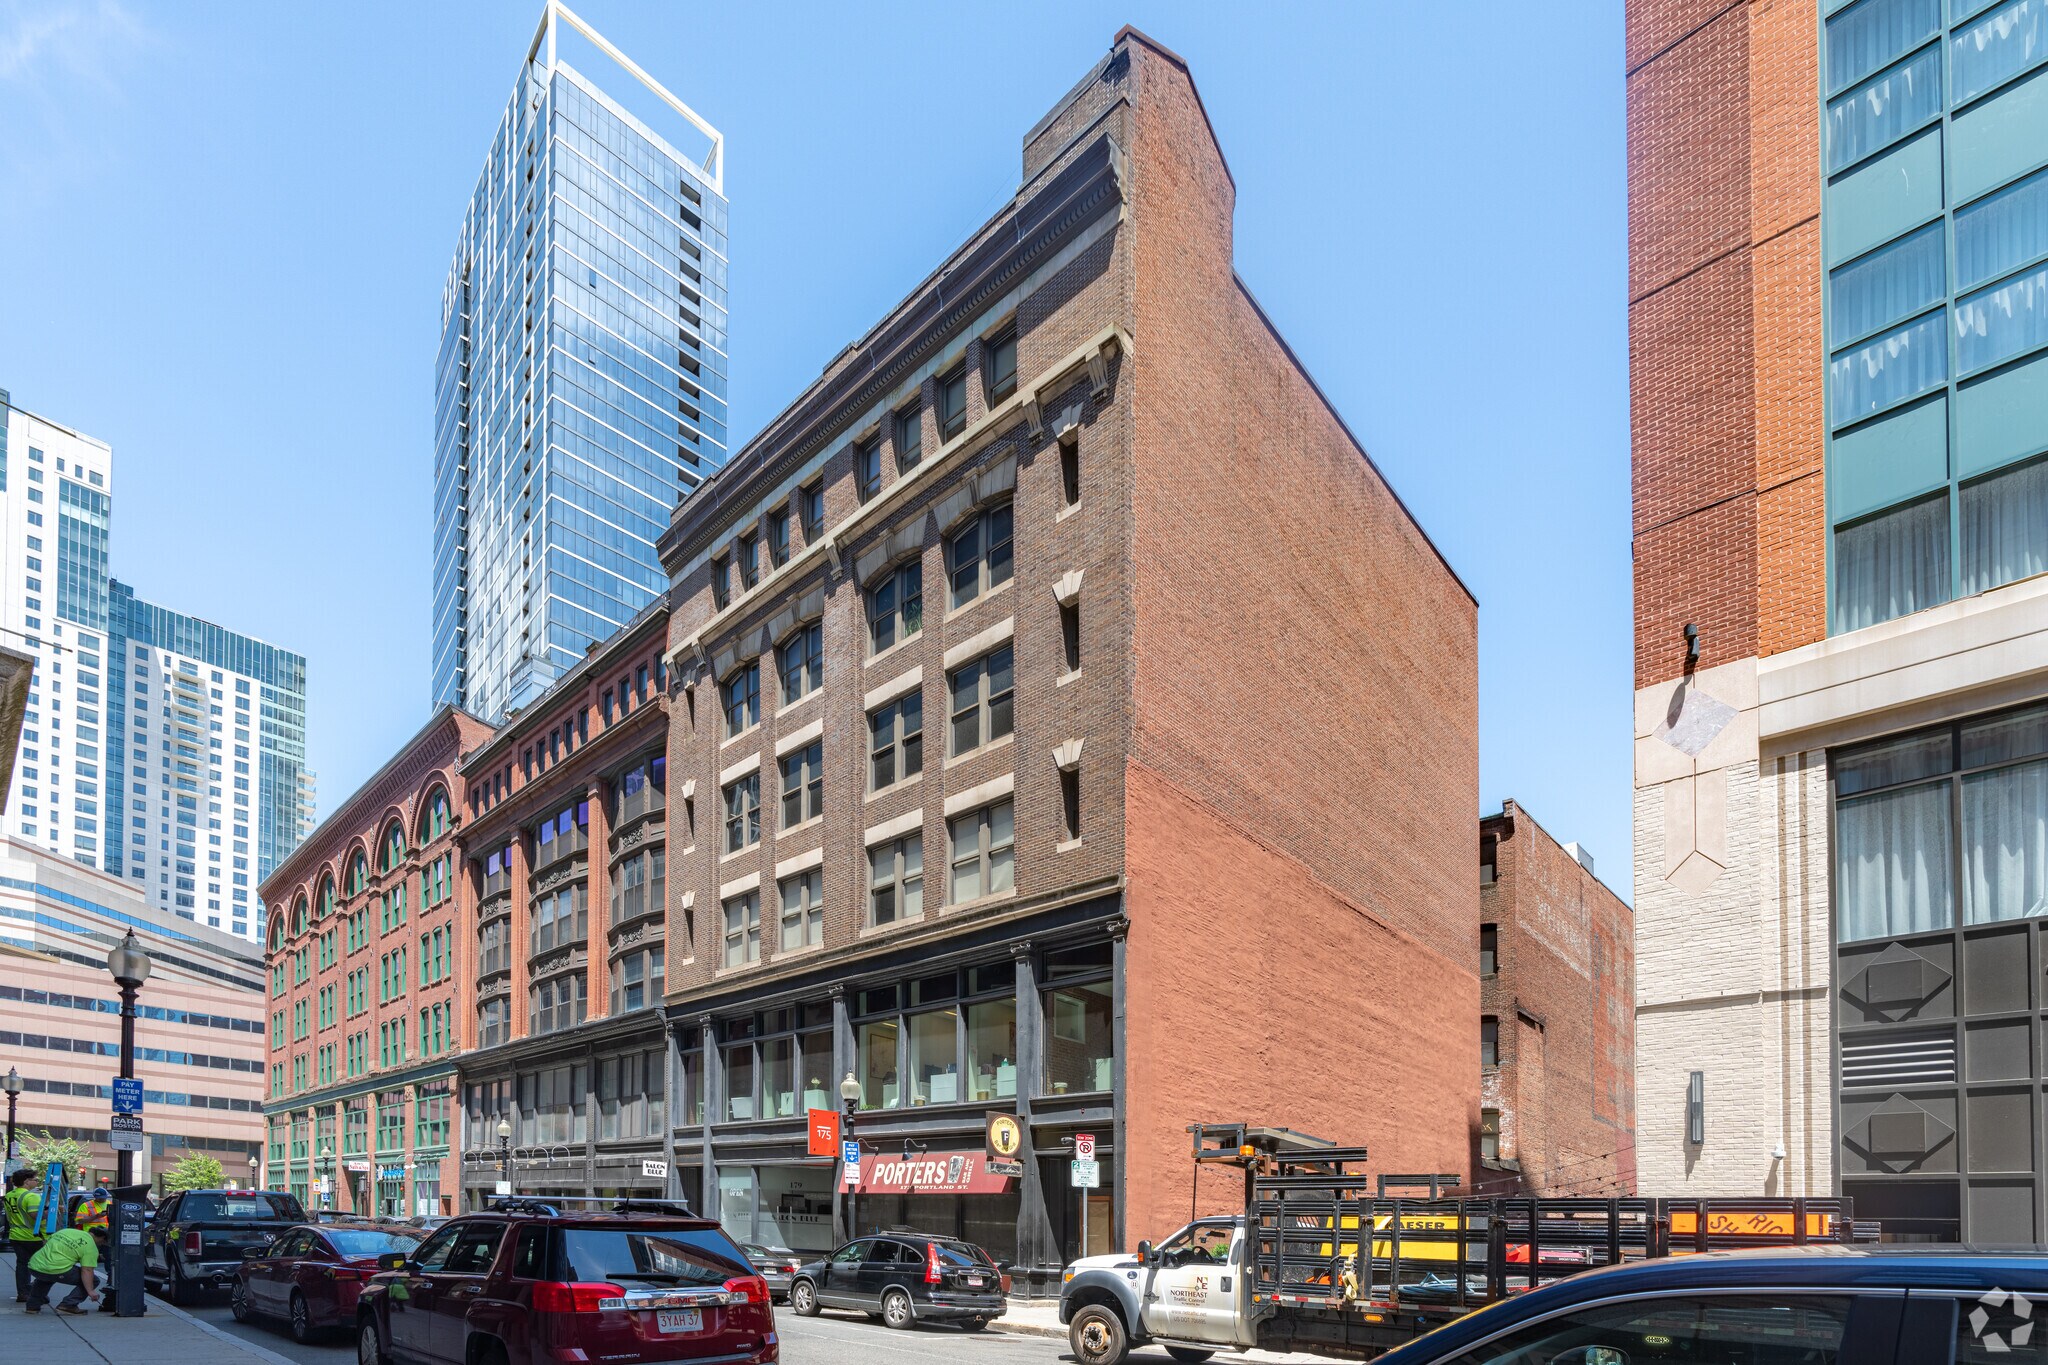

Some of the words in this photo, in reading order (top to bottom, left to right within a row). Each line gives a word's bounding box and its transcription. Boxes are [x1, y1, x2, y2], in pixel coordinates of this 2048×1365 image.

[113, 1117, 141, 1125] PARK
[816, 1129, 832, 1140] 175
[872, 1160, 947, 1184] PORTERS
[772, 1214, 798, 1222] SLON
[1388, 1221, 1446, 1231] AESER
[1170, 1289, 1208, 1299] NORTHEAST
[668, 1296, 698, 1305] GMC
[659, 1314, 687, 1327] 3YAH
[687, 1313, 700, 1326] 37
[599, 1352, 641, 1361] TERRAIN
